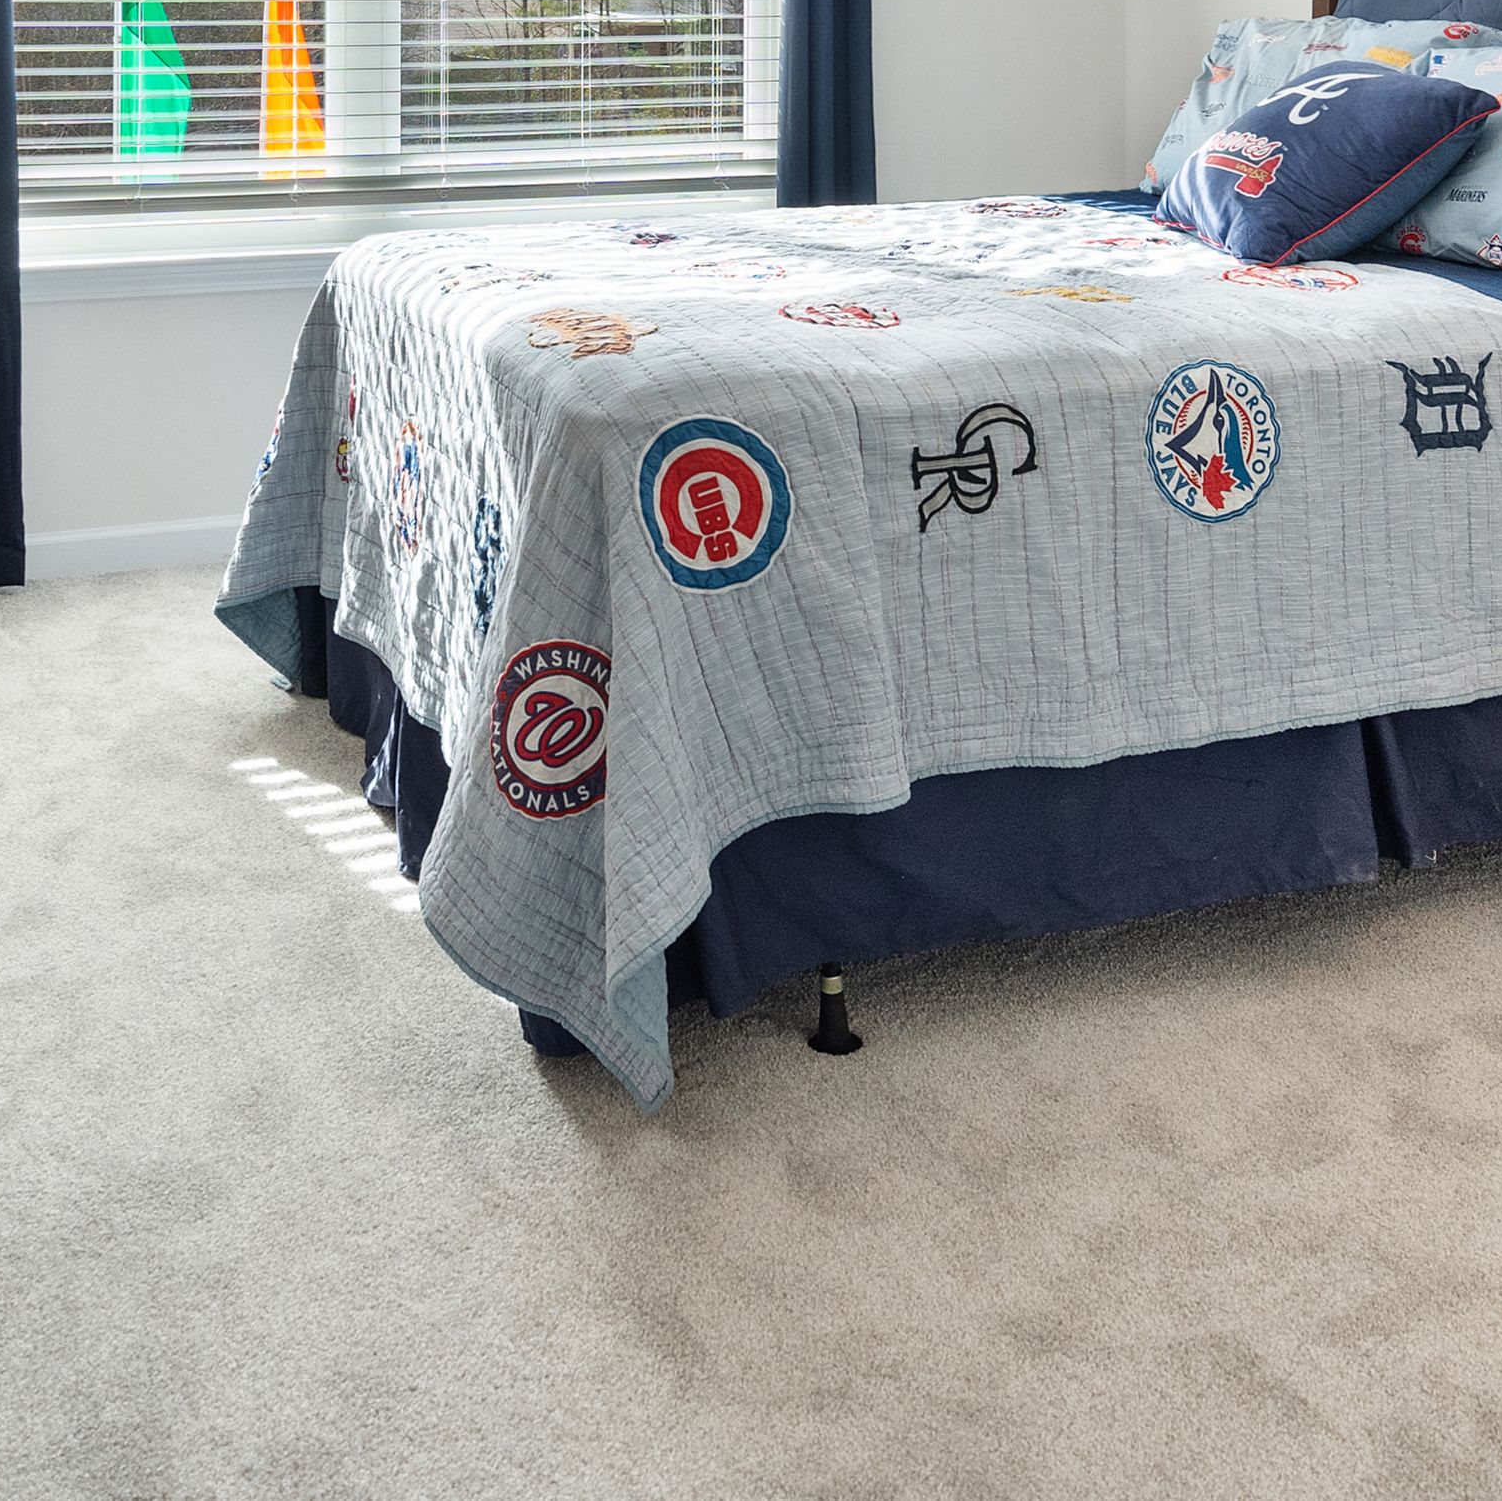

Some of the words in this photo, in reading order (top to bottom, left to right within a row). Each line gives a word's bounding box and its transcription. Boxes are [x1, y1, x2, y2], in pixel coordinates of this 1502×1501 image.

[1257, 72, 1384, 125] A
[1445, 188, 1488, 203] MARINERS
[1155, 374, 1199, 436] BLUE
[1226, 373, 1272, 475] TORONTO
[1155, 450, 1198, 507] JAYS
[513, 649, 611, 693] WASHIN
[492, 721, 591, 812] NATIONALS
